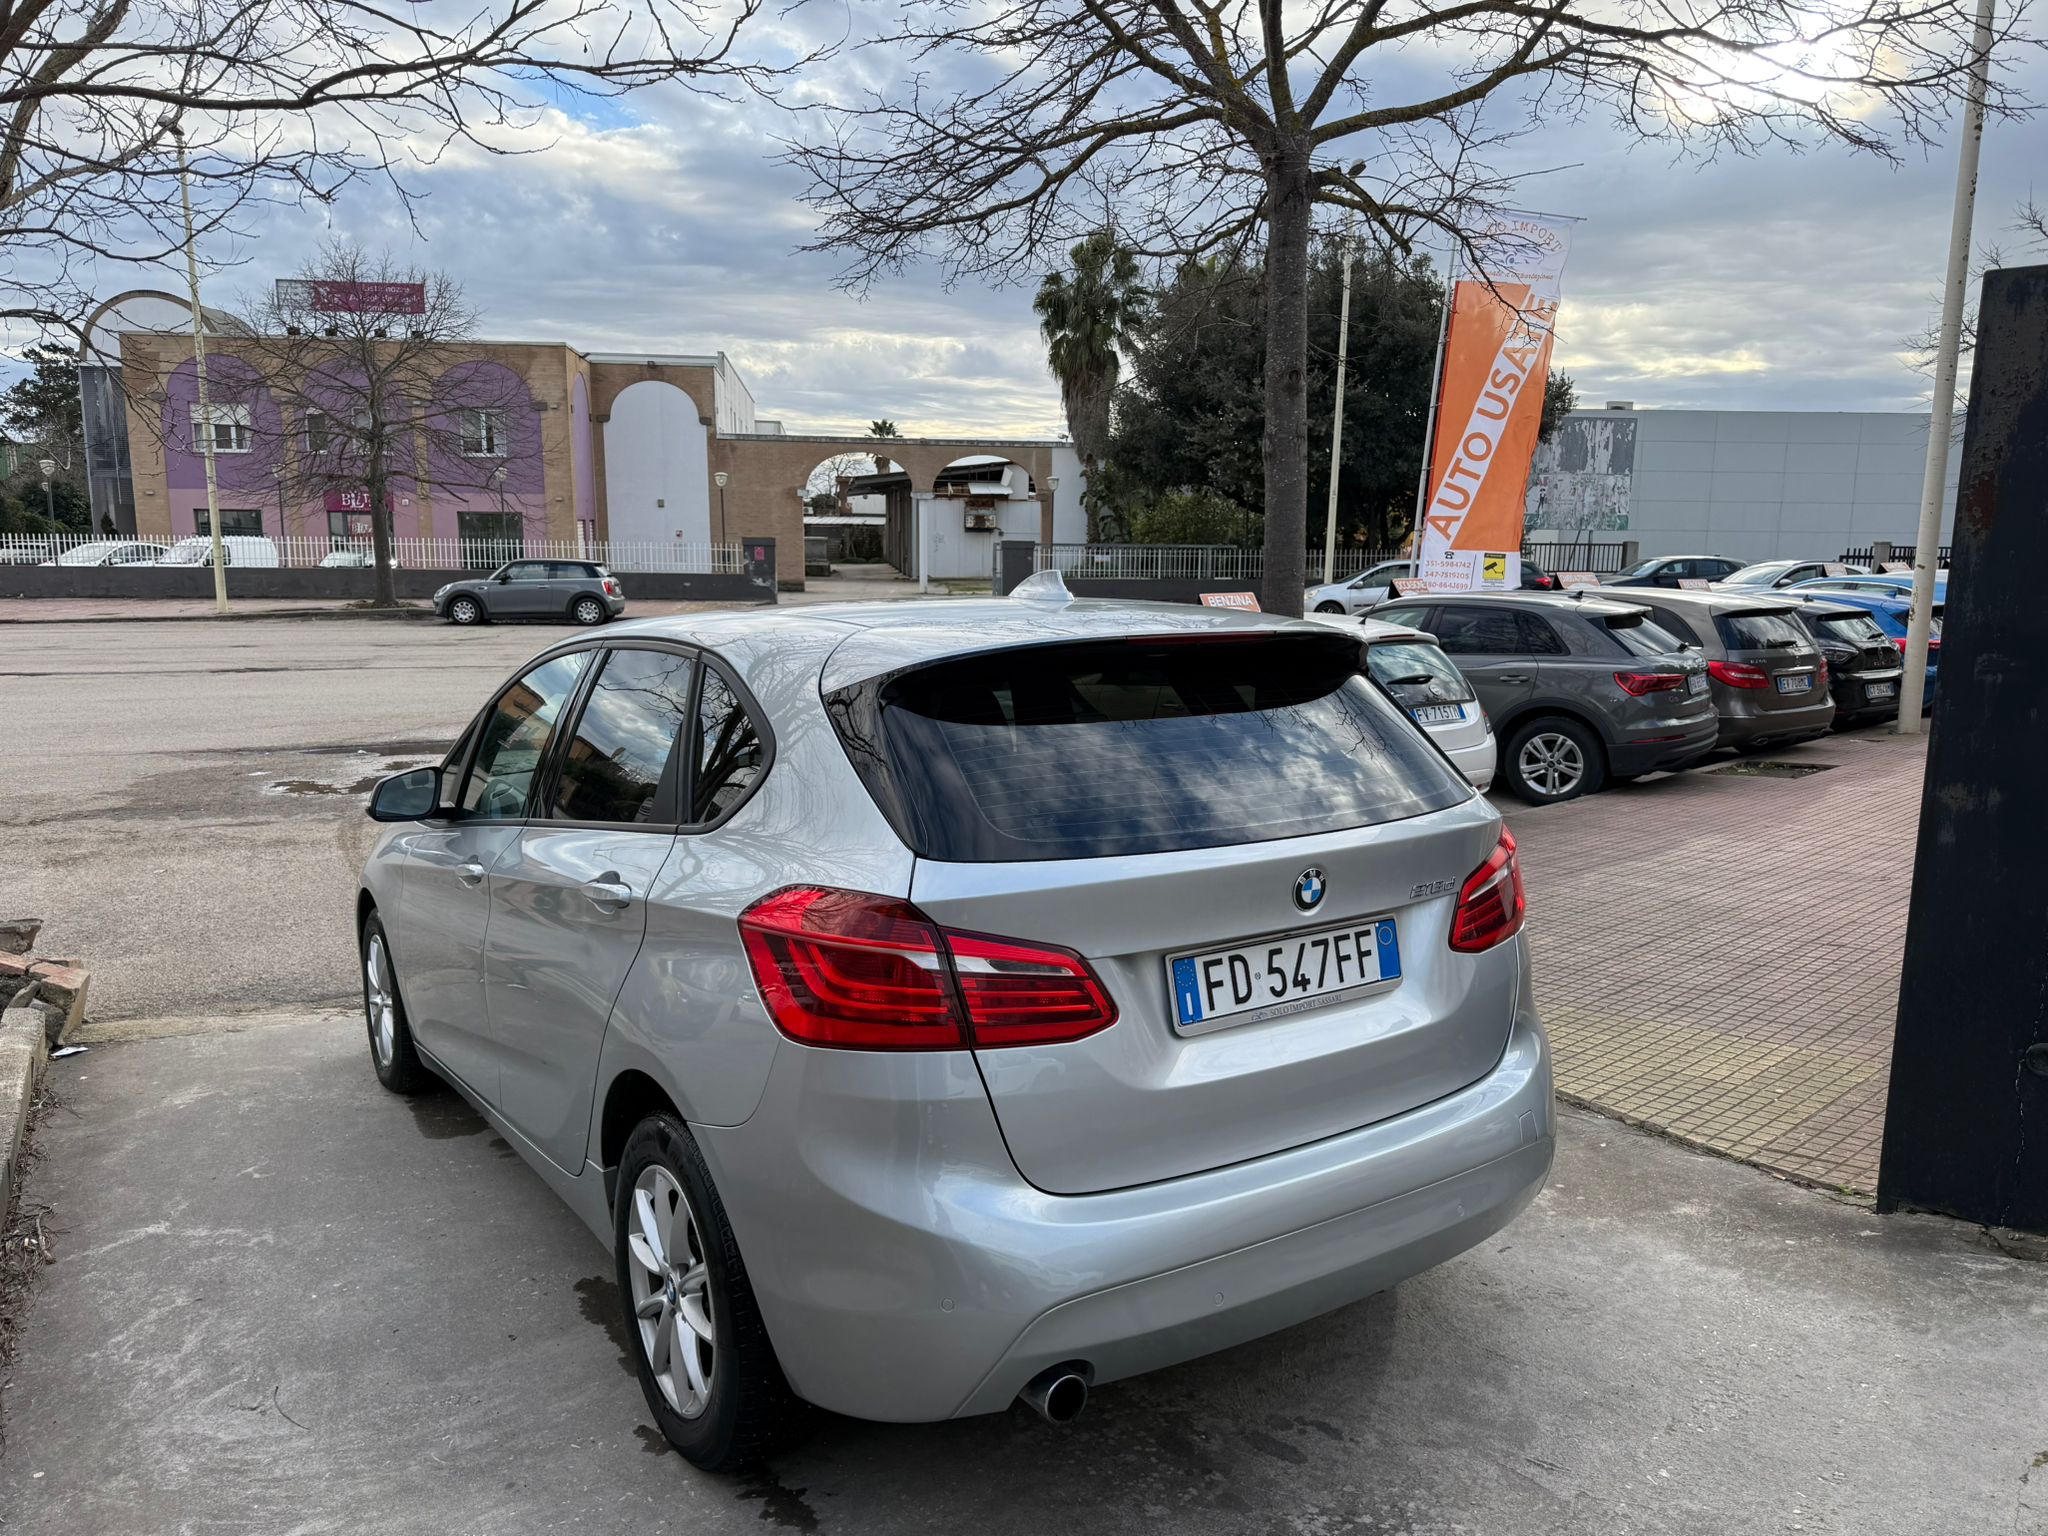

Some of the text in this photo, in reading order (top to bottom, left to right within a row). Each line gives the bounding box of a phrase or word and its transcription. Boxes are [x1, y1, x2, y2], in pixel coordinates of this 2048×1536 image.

[1511, 221, 1562, 252] IMPORT
[1428, 432, 1492, 540] AUTO
[1207, 595, 1254, 607] BENZINA
[1202, 953, 1253, 1011] FD
[1267, 929, 1372, 998] 547FF
[1269, 1006, 1289, 1017] SOLO
[1289, 999, 1316, 1012] IMPORT
